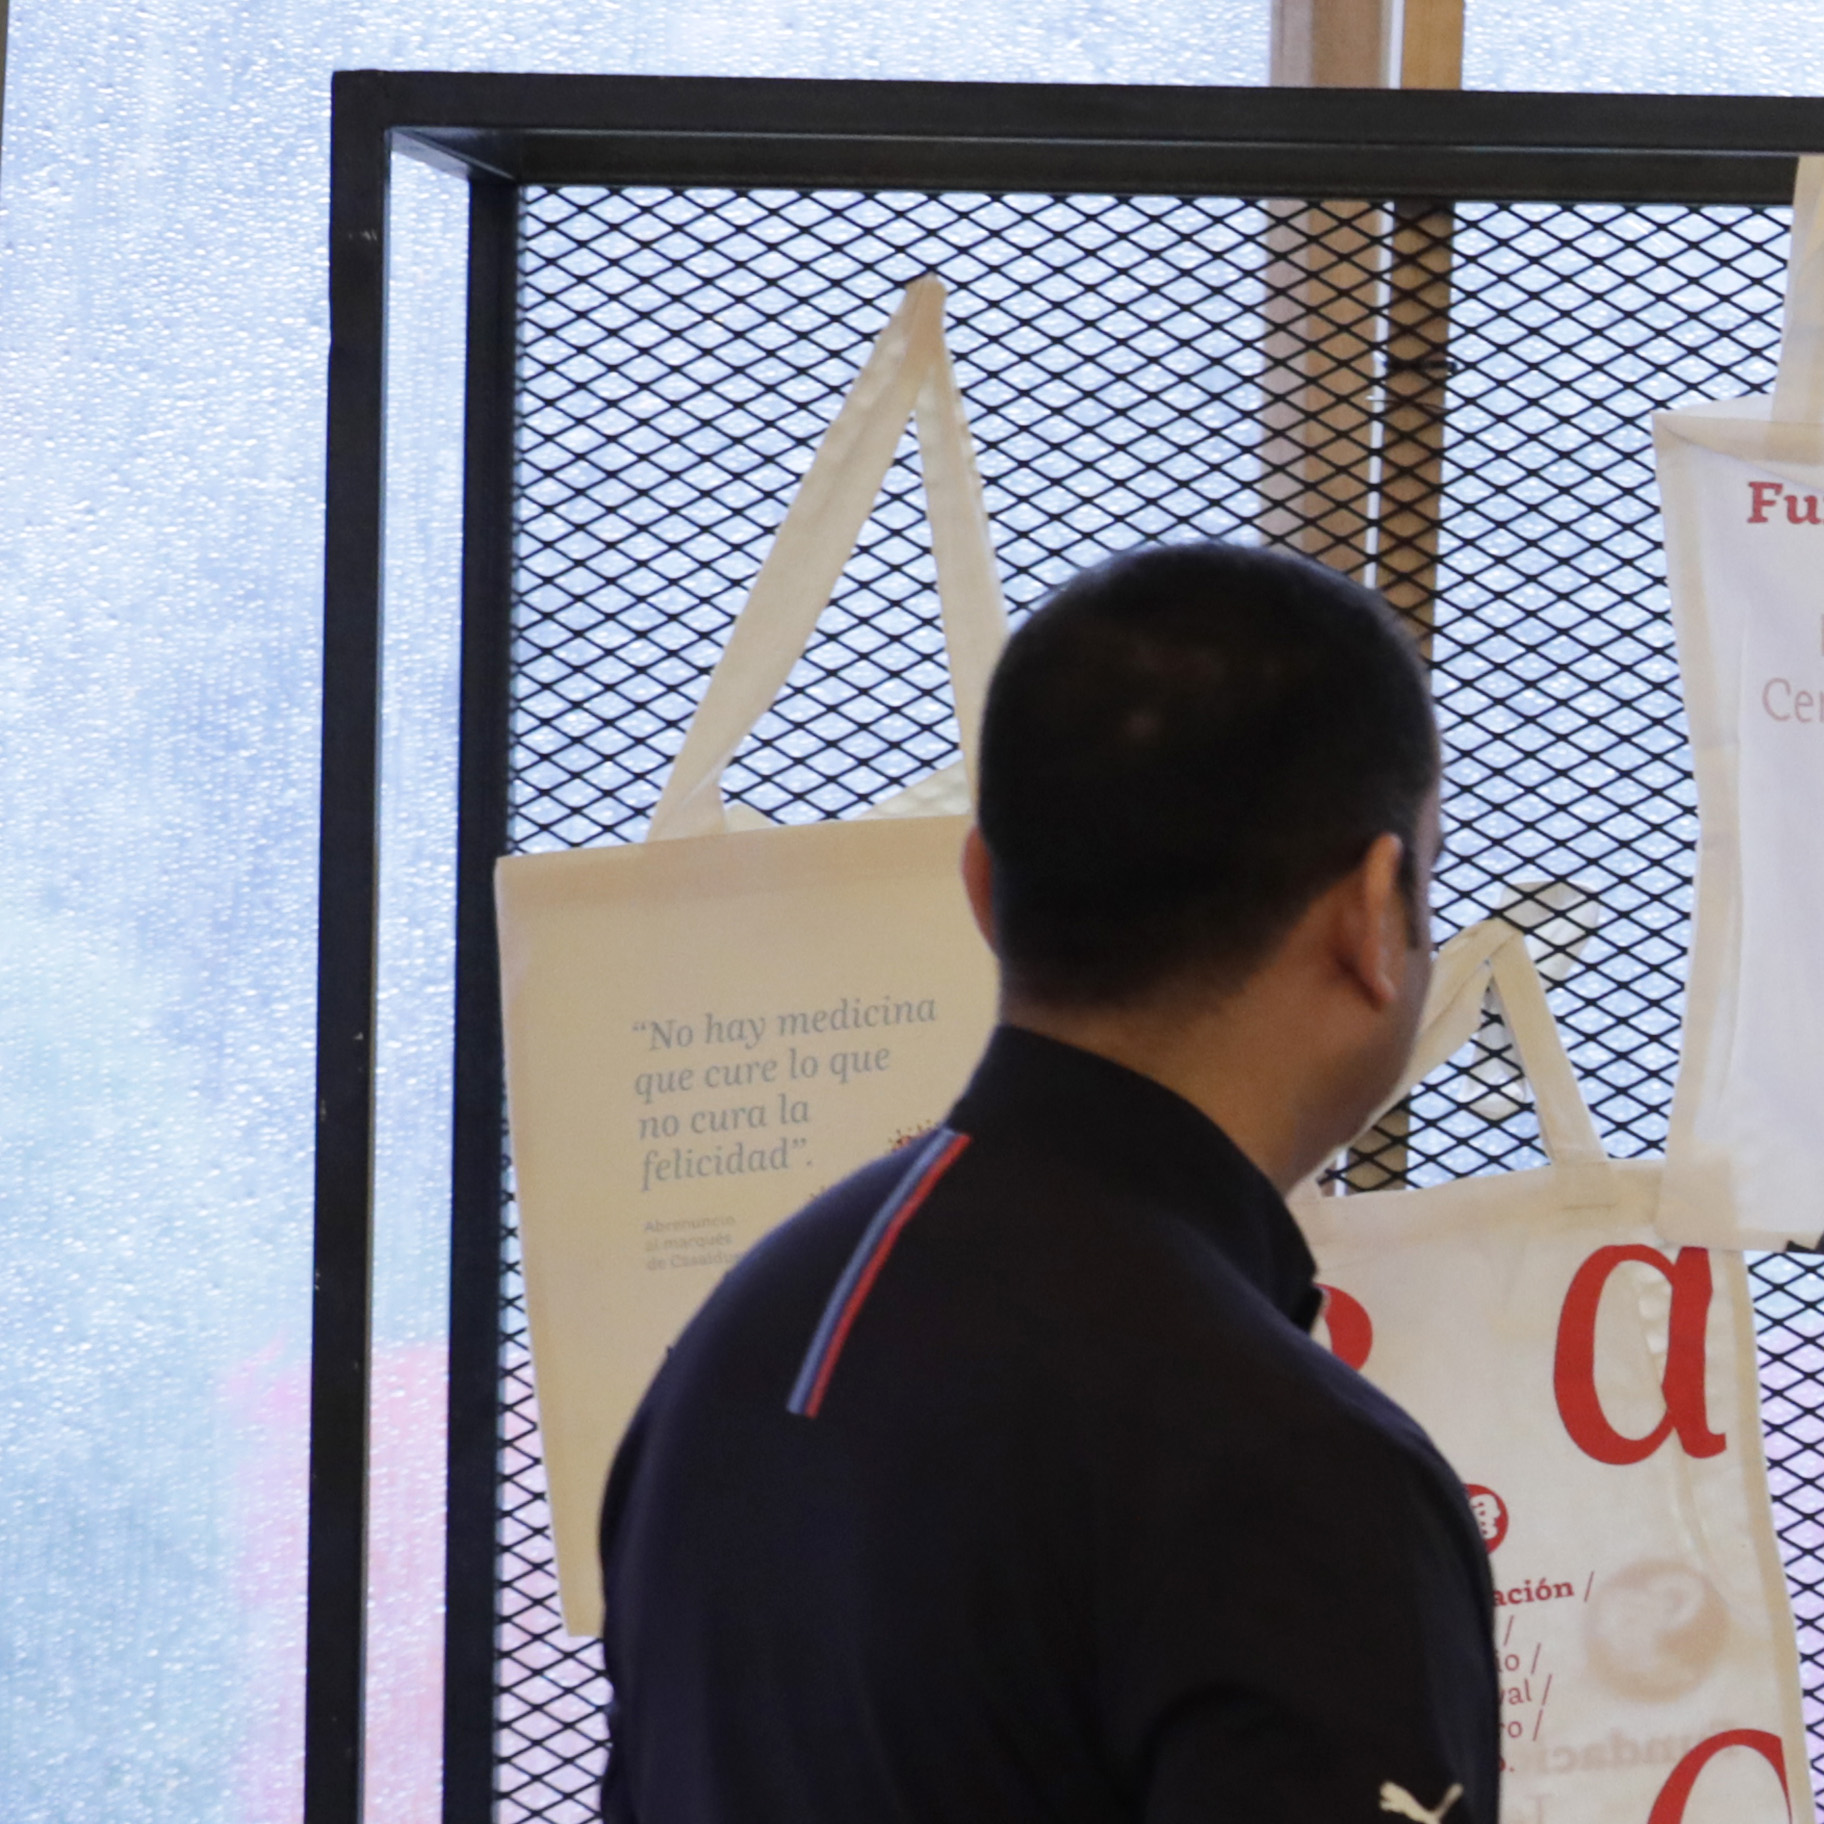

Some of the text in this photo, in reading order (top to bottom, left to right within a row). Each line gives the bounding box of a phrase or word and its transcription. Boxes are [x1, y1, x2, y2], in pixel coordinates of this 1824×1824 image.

[704, 1013, 766, 1050] hay
[776, 995, 937, 1038] medicina
[634, 1046, 890, 1104] que cure lo que
[638, 1093, 810, 1140] no cura la
[1553, 1243, 1728, 1465] a
[1492, 1577, 1576, 1608] ación
